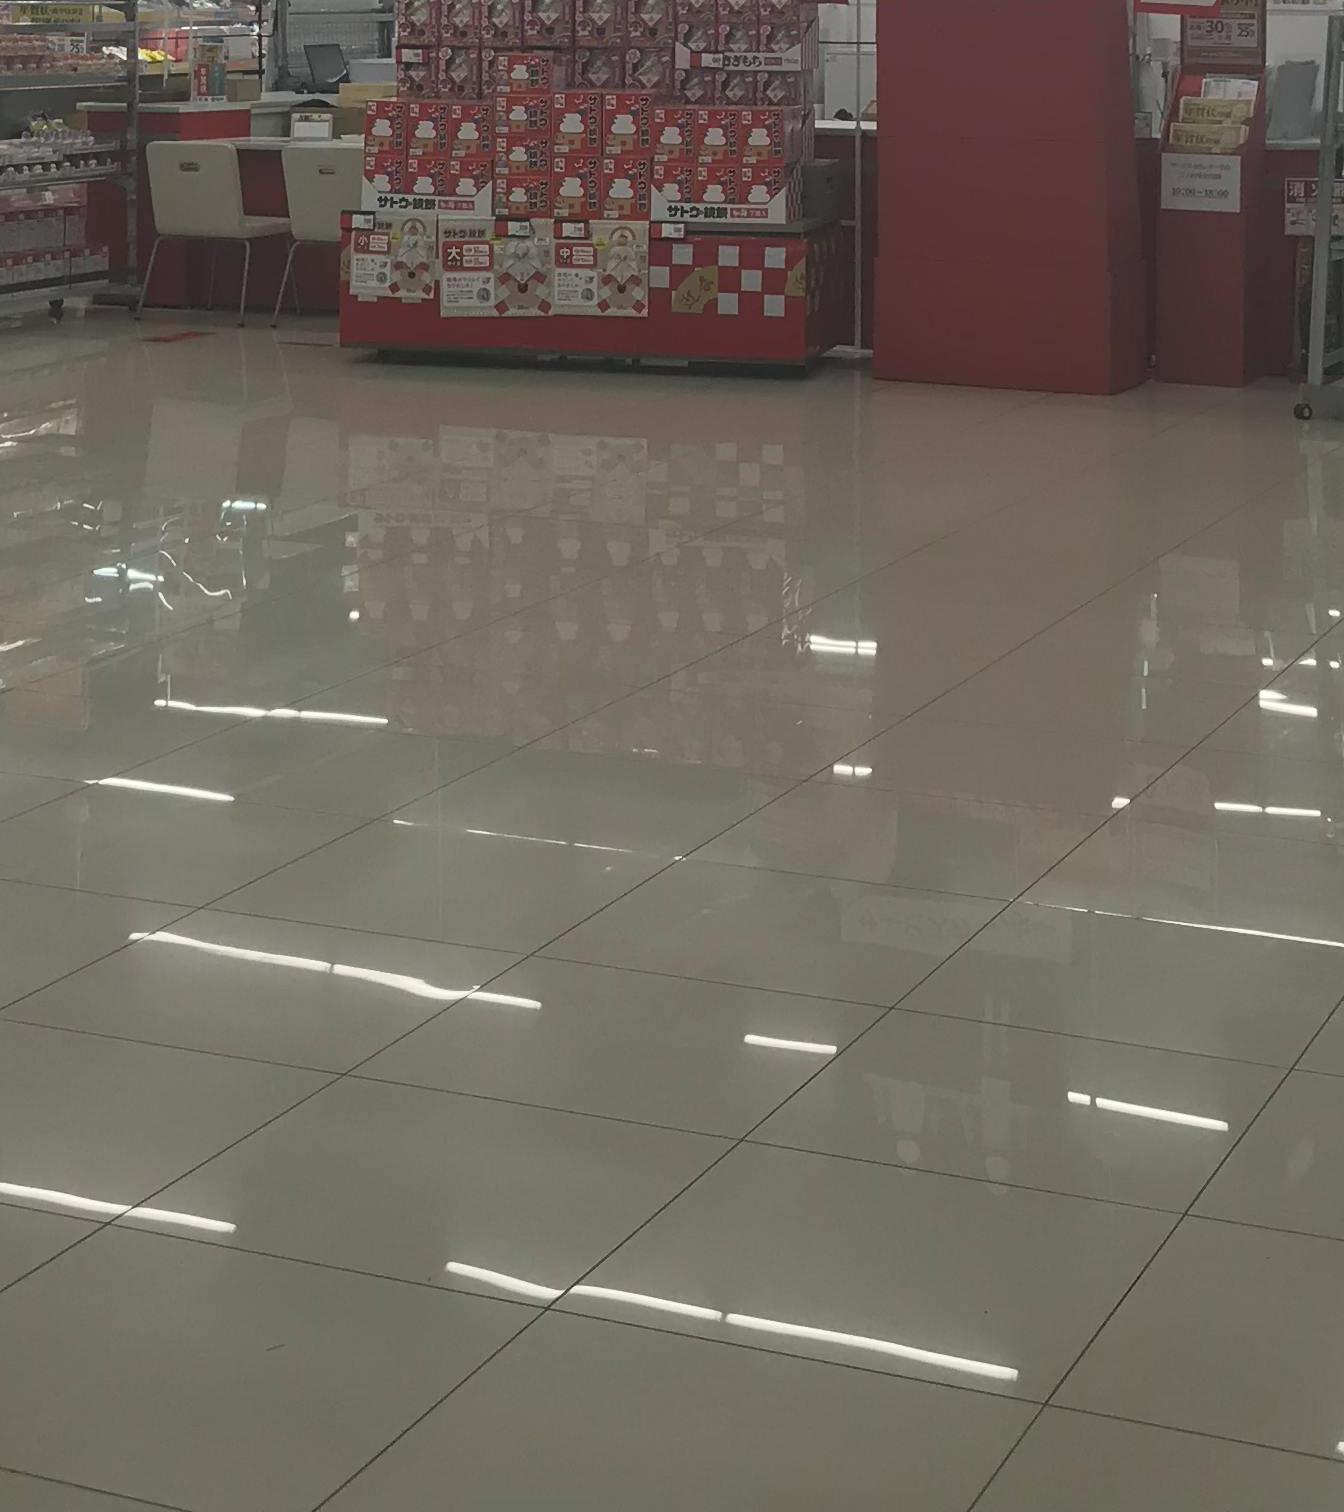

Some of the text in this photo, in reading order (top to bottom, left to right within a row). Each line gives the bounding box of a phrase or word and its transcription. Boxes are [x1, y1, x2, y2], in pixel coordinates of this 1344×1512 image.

[722, 53, 762, 68] さぎもち
[358, 234, 369, 247] 小
[447, 246, 461, 261] 大
[559, 248, 571, 258] 中
